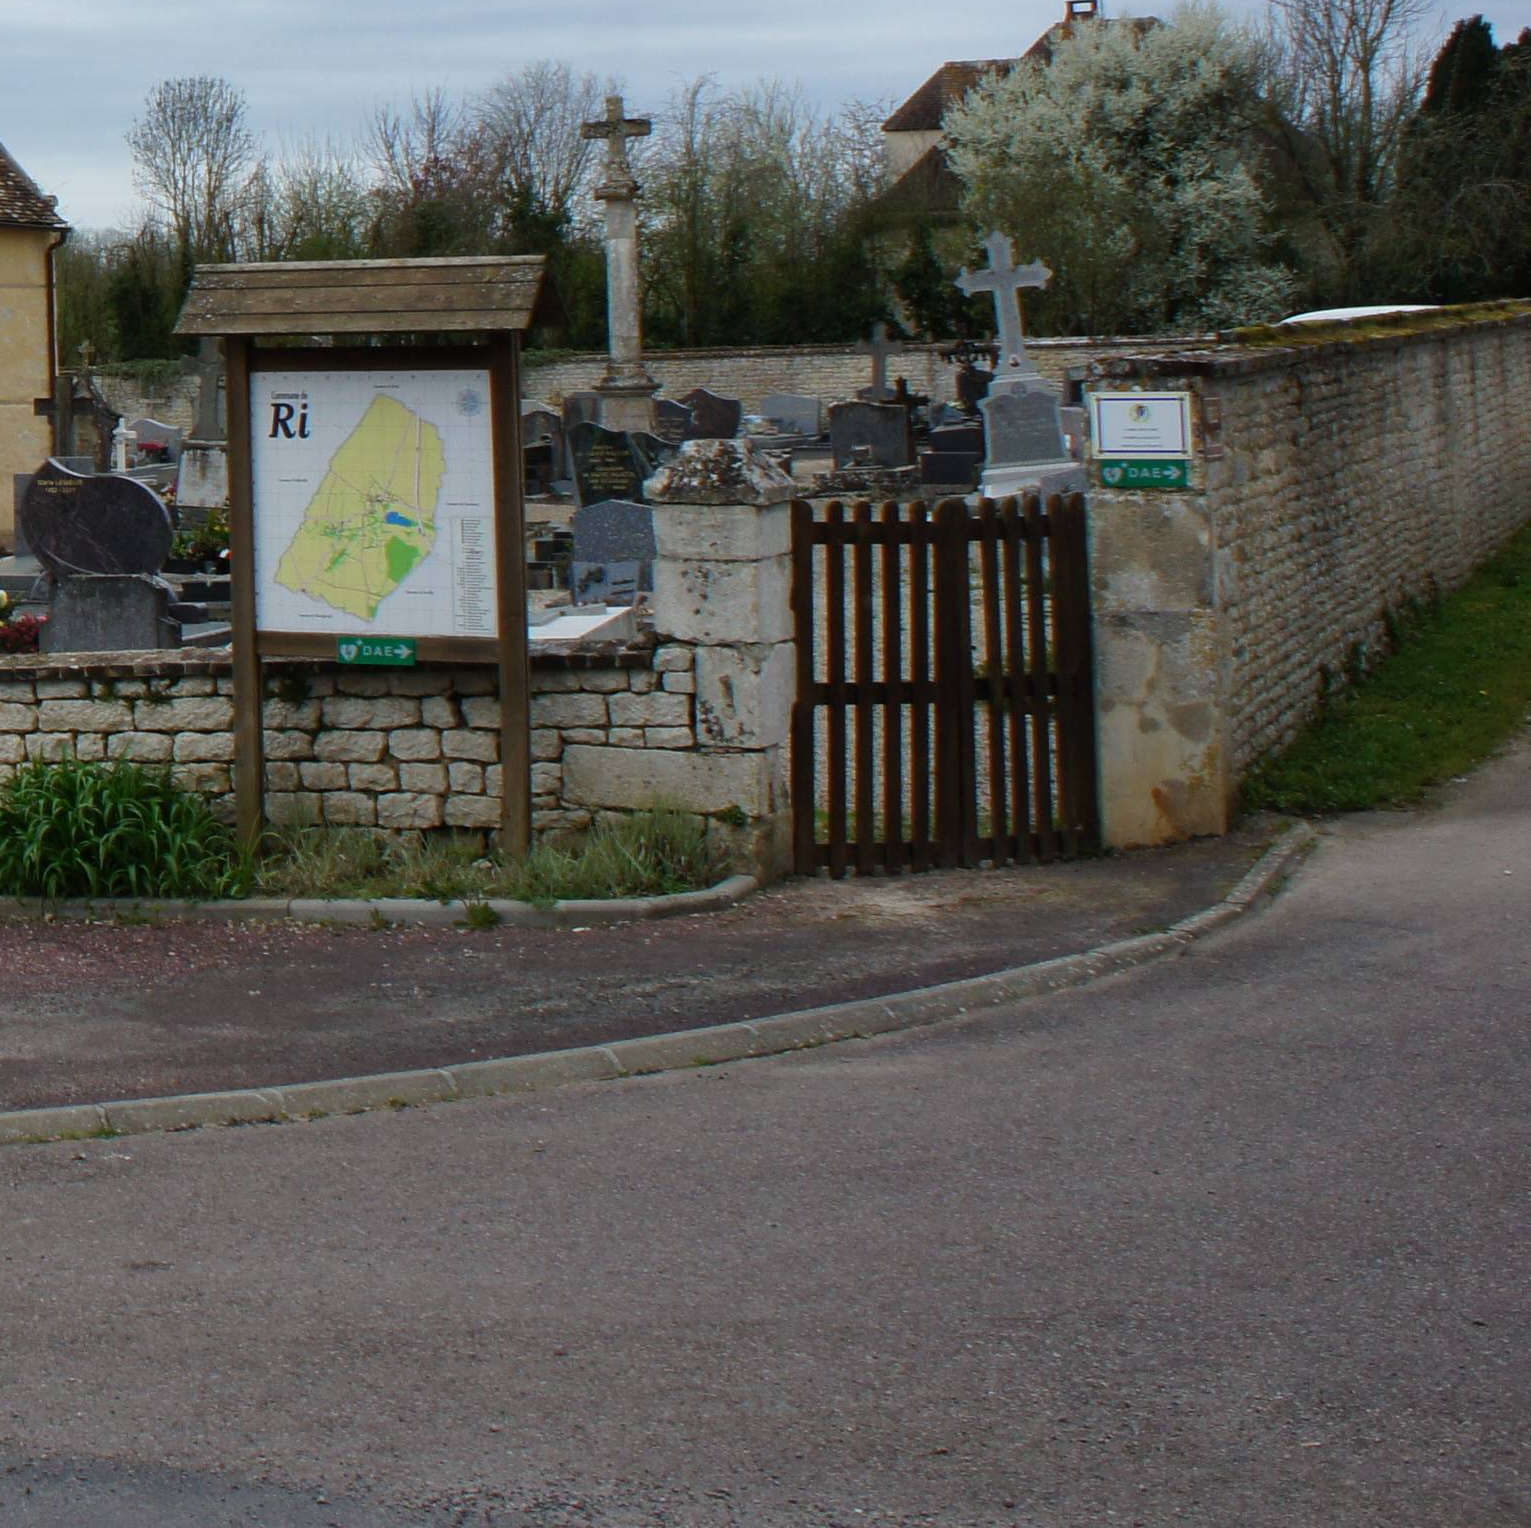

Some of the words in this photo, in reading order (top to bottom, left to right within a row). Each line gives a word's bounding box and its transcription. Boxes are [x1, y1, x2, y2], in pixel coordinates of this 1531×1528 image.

[268, 402, 311, 439] Ri
[1128, 467, 1162, 478] DAE
[362, 645, 394, 657] DAE
